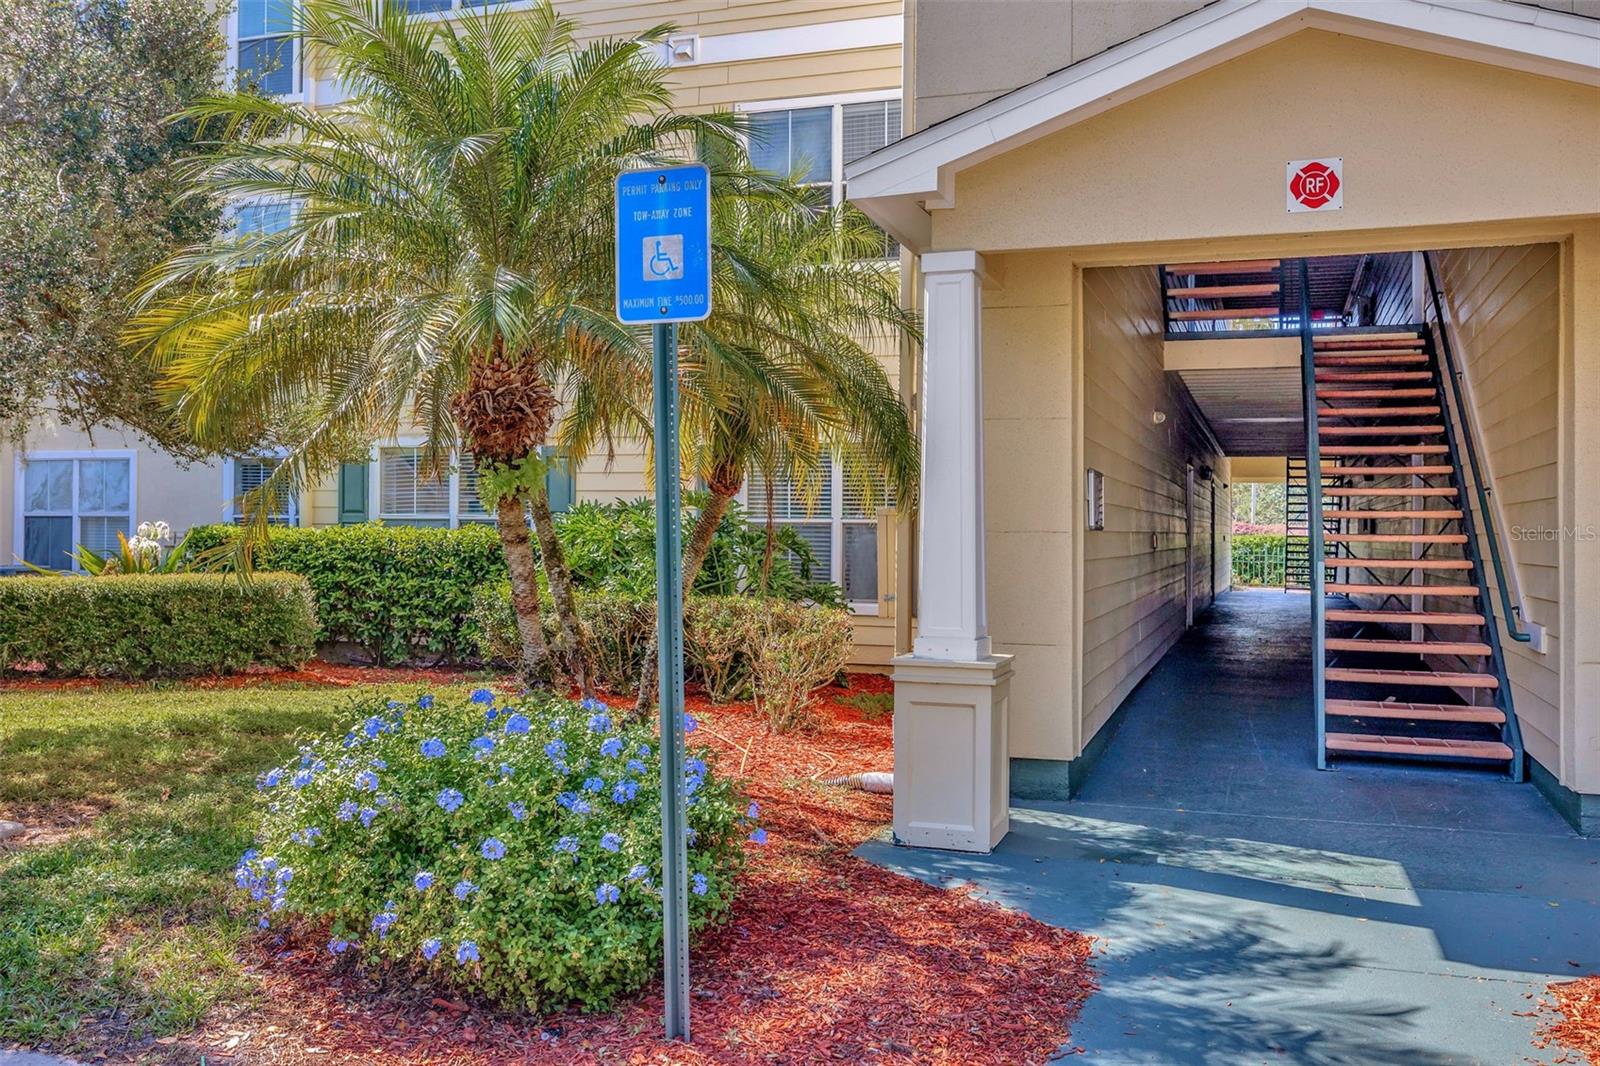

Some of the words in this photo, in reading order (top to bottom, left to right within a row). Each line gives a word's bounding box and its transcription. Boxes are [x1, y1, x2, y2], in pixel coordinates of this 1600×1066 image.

[623, 184, 647, 196] PERMIT
[651, 182, 680, 193] PARKING
[684, 180, 703, 191] ONLY
[1305, 177, 1324, 194] RF
[633, 209, 669, 221] TOW-AWAY
[673, 206, 692, 218] ZONE
[623, 298, 654, 309] MAXIMUM
[657, 296, 672, 307] FINE
[675, 294, 704, 306] $500.00
